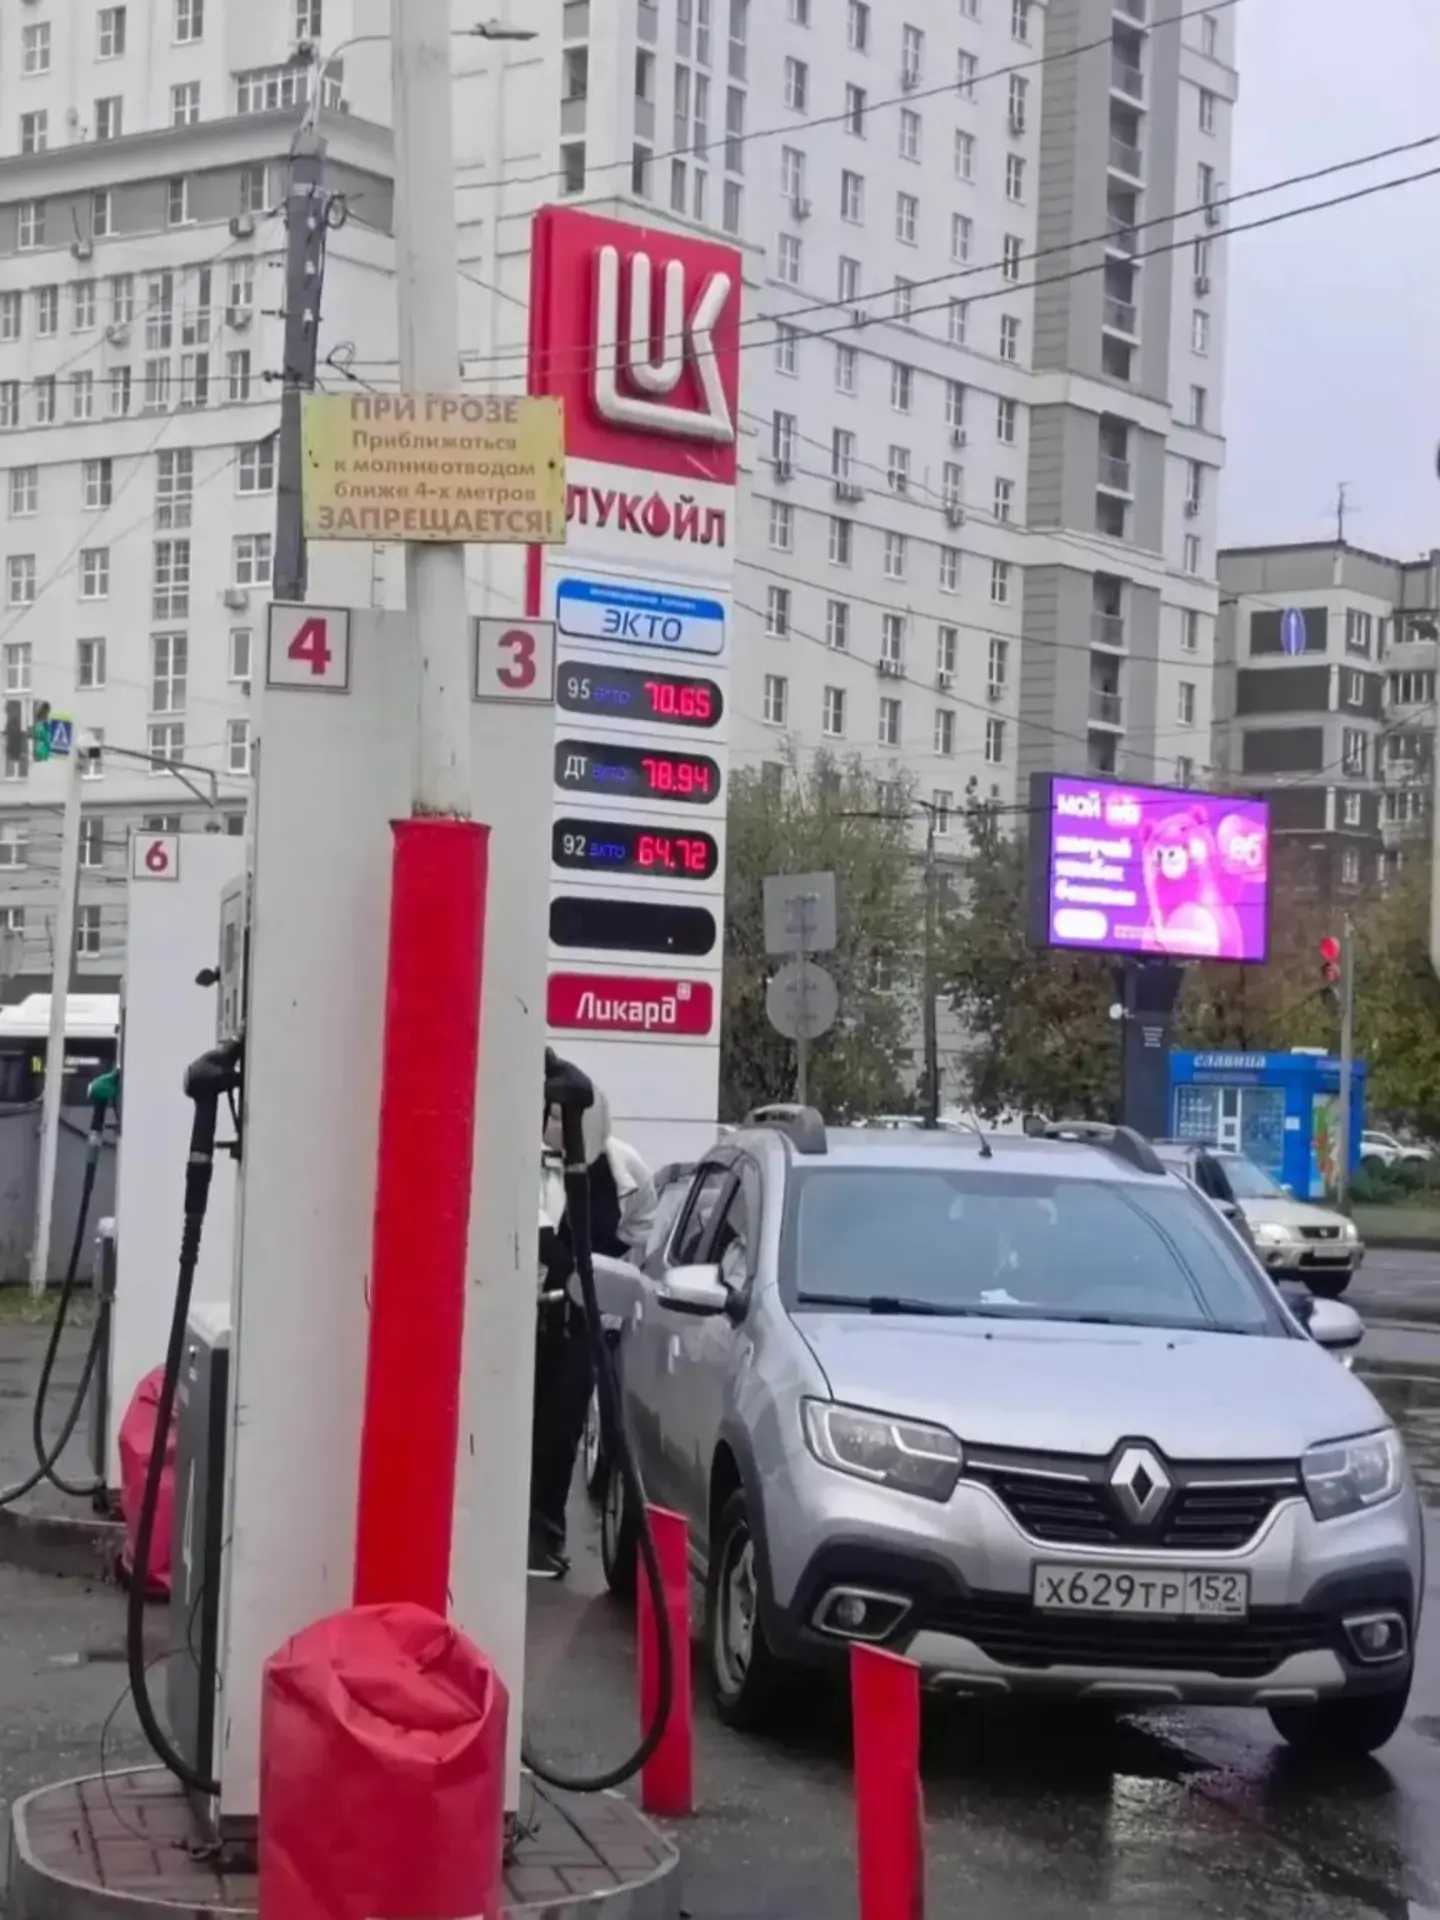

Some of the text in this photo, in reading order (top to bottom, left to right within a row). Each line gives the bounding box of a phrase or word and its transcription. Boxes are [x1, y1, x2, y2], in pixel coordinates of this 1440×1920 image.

[350, 397, 519, 424] ПРИ ГРОЗЕ
[352, 430, 518, 451] Приближаться
[334, 480, 409, 498] ближе
[456, 486, 537, 504] метров
[316, 505, 553, 536] ЗАПРЕЩАЕТСЯ!
[602, 608, 683, 643] ЭКТО
[287, 617, 332, 676] 4
[495, 629, 537, 690] 3
[566, 676, 591, 700] 95
[643, 681, 712, 719] 70.65
[564, 754, 587, 781] ДТ
[641, 758, 710, 794] 78.94
[144, 840, 169, 873] 6
[562, 834, 586, 857] 92
[637, 836, 708, 870] 64.72
[576, 992, 677, 1029] Ликард
[1188, 1575, 1238, 1603] 152
